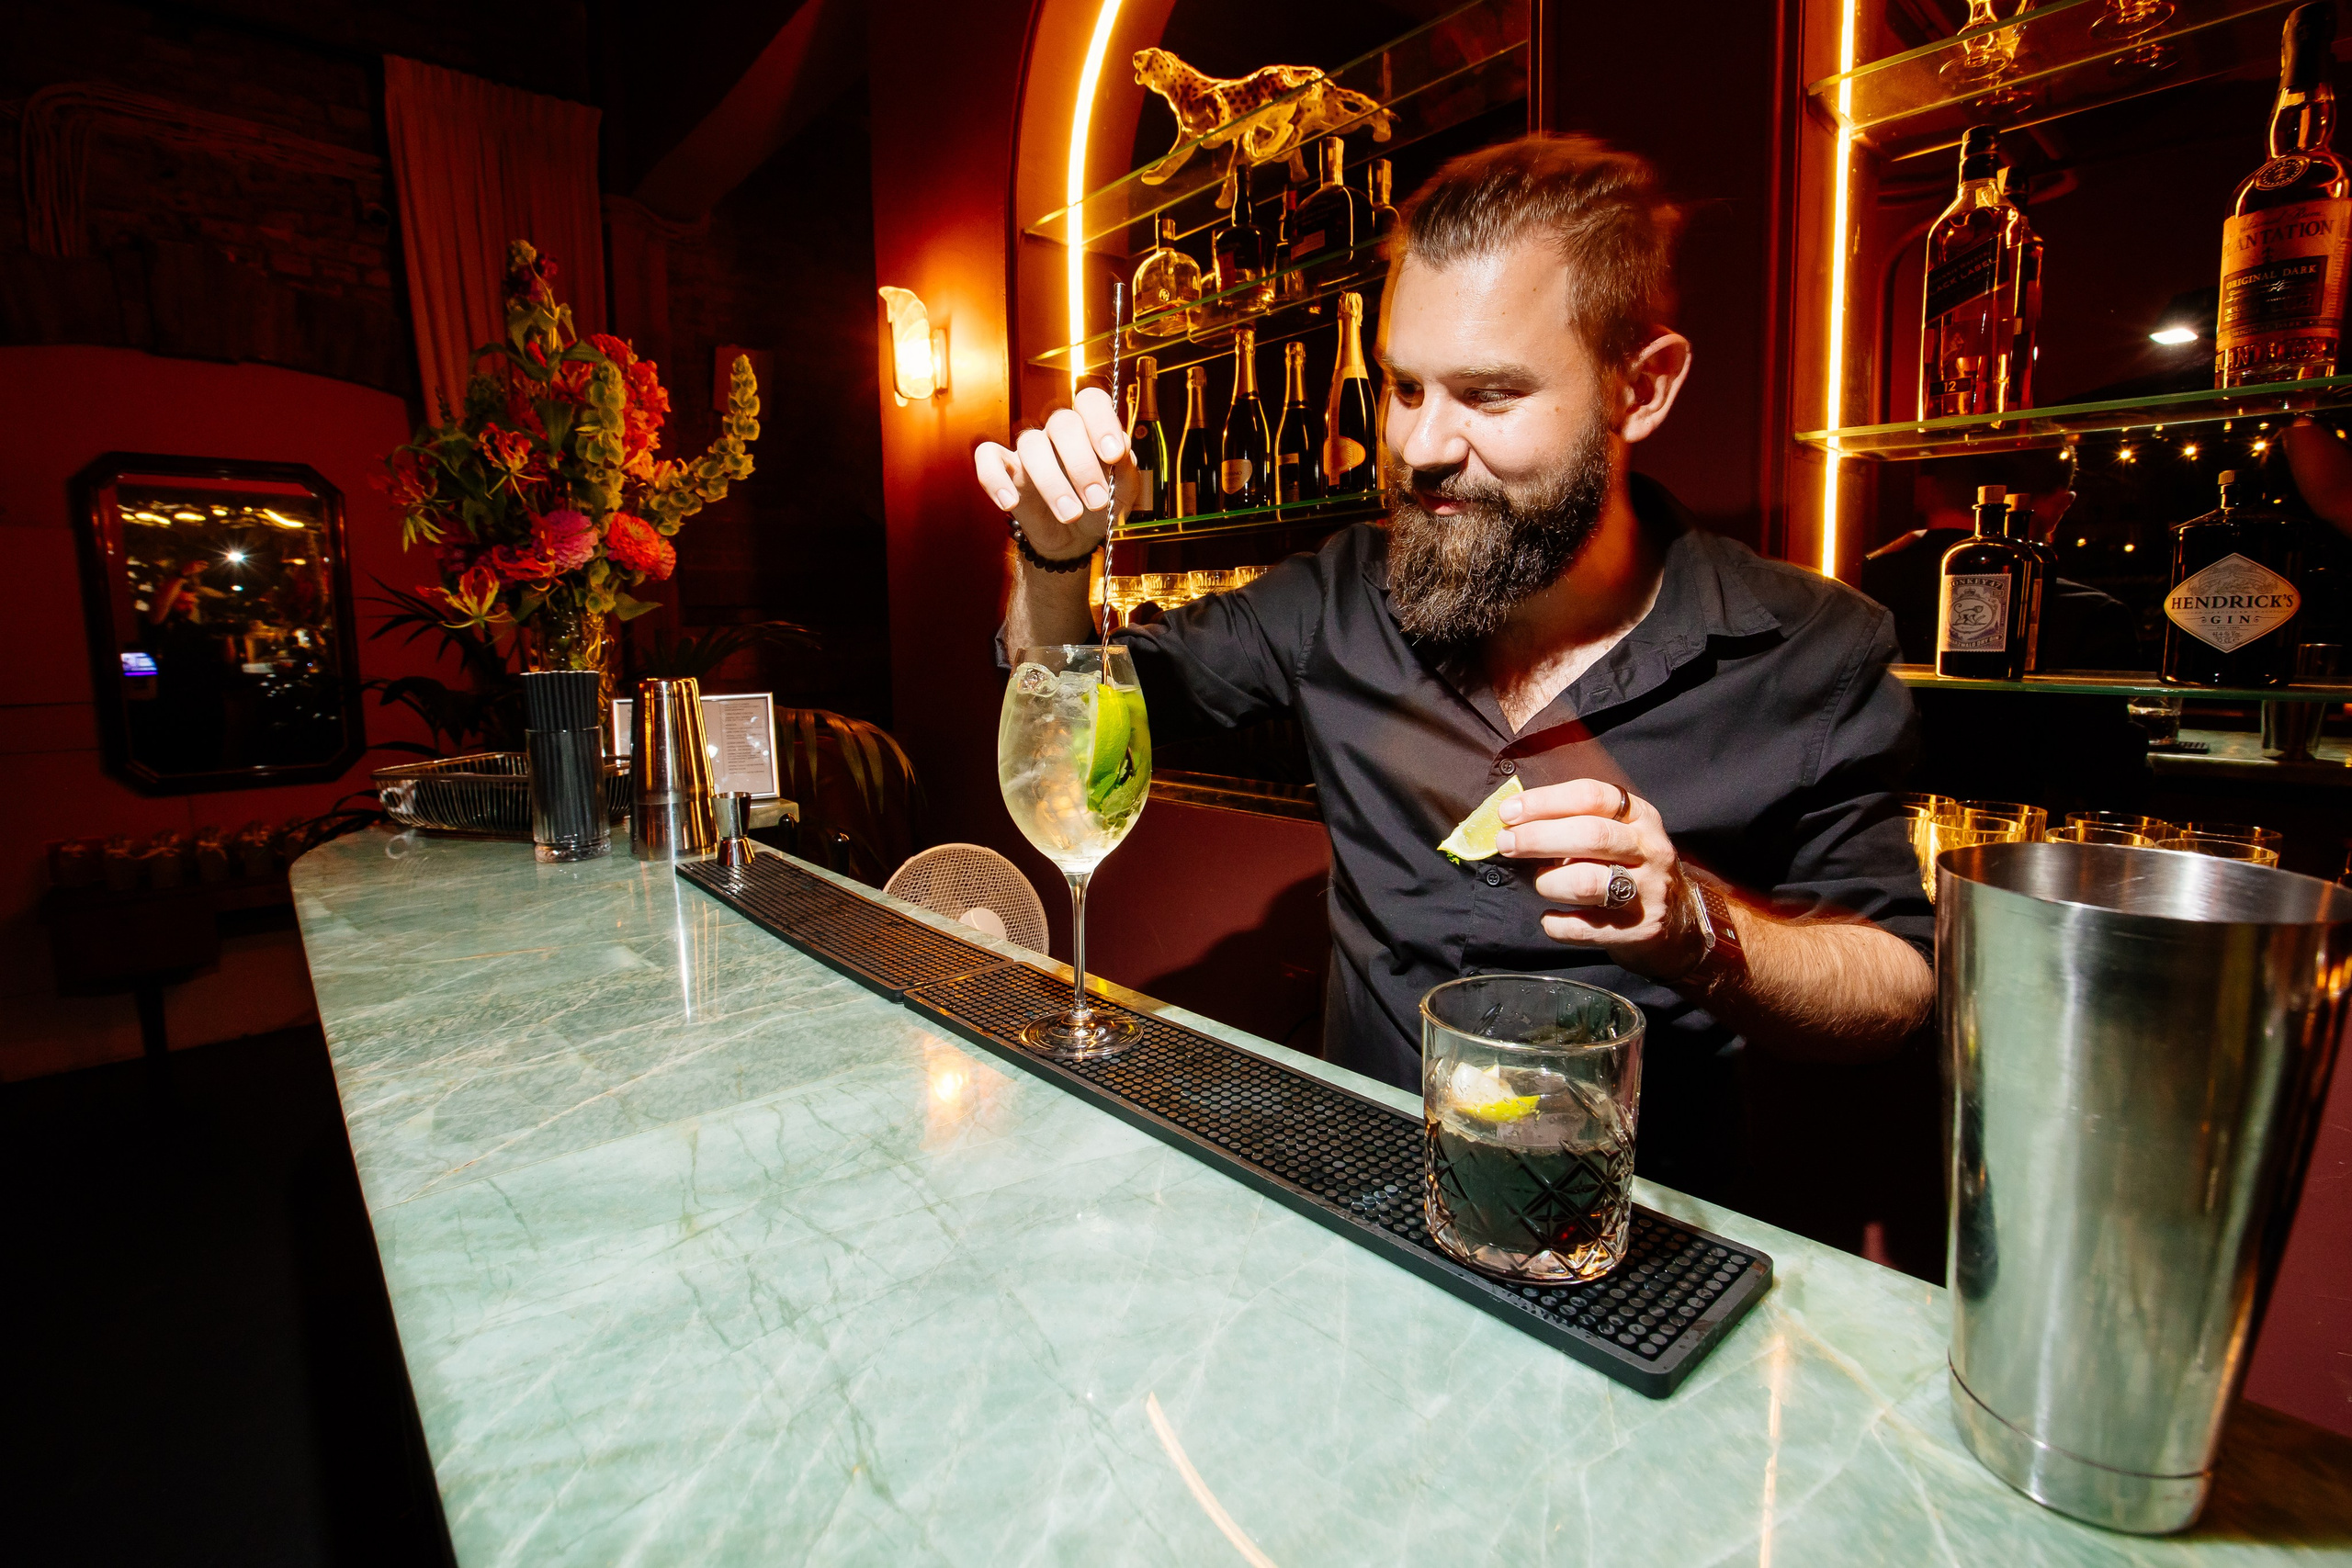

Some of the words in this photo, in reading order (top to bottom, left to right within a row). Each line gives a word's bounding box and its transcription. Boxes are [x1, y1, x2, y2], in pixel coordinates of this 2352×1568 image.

[1960, 258, 1996, 279] LABEL
[2226, 270, 2278, 290] ORIGINAL
[2282, 264, 2317, 276] DARK
[1943, 380, 1956, 392] 12
[2171, 593, 2294, 610] HENDRICK'S
[2211, 615, 2251, 625] GIN
